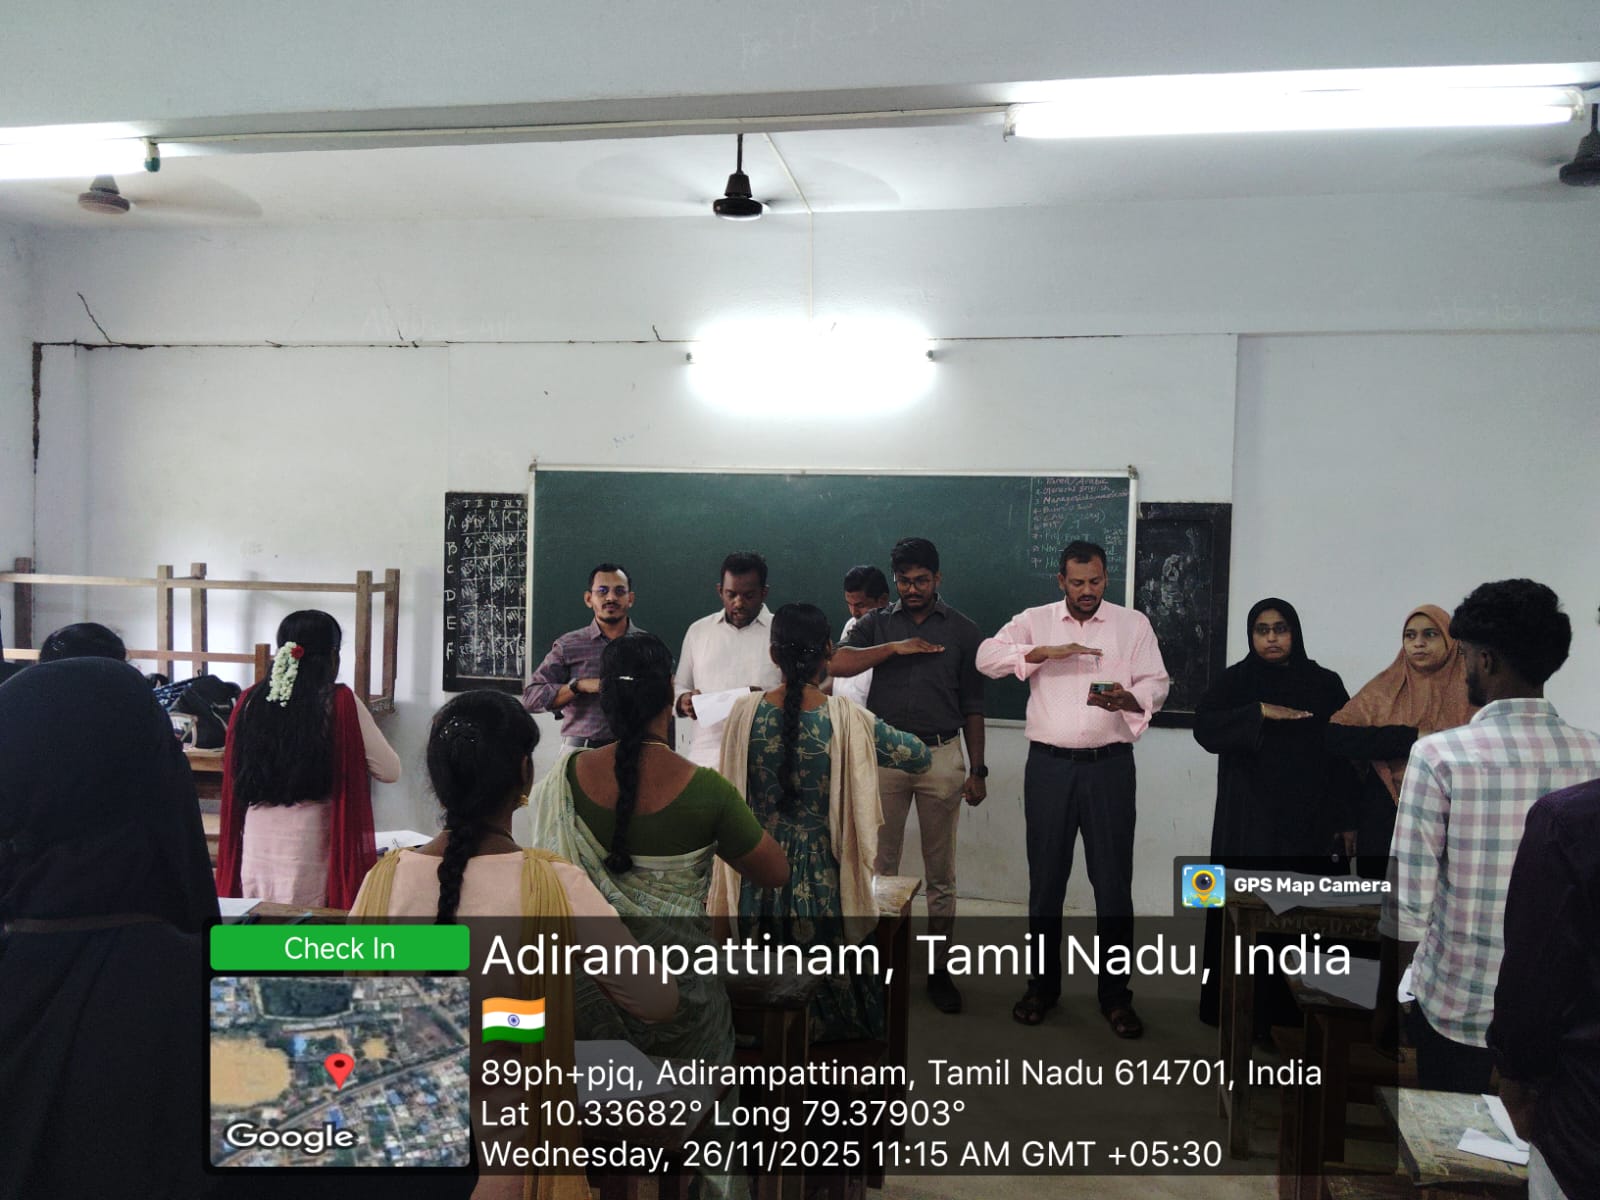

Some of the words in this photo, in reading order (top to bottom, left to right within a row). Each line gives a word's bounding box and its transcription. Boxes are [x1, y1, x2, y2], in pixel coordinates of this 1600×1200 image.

[444, 589, 456, 602] D
[446, 615, 457, 630] E
[446, 642, 455, 661] F
